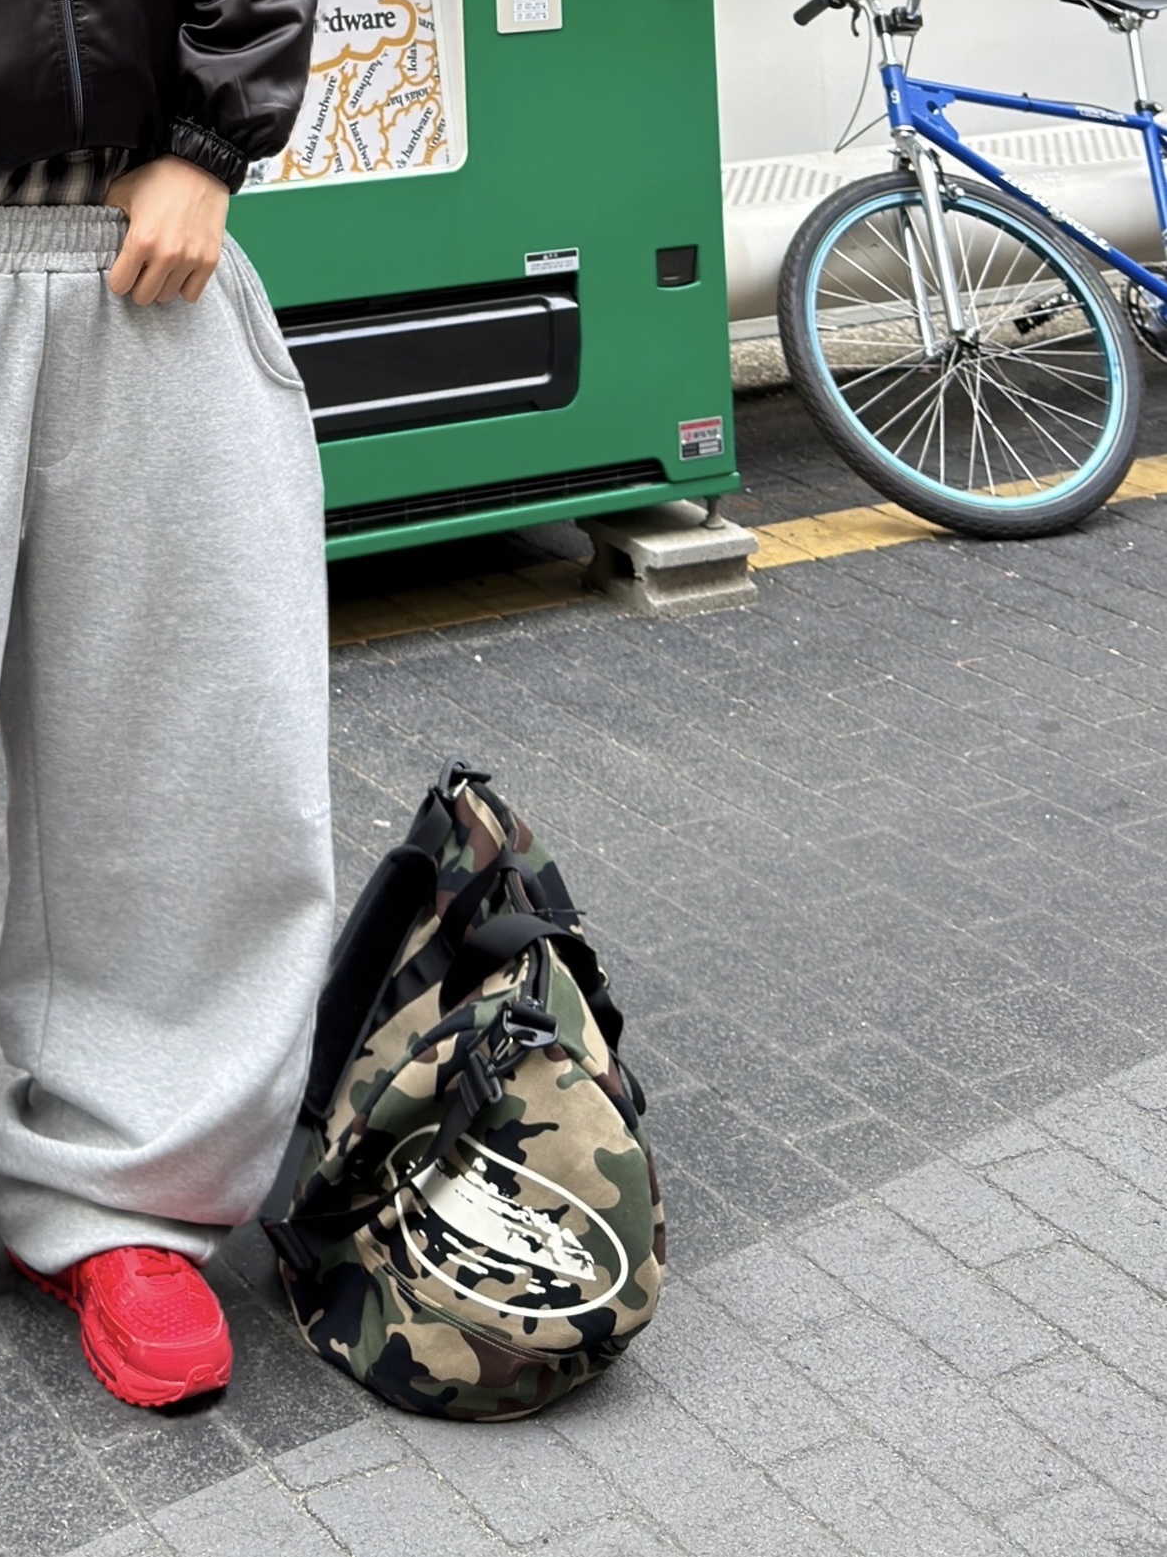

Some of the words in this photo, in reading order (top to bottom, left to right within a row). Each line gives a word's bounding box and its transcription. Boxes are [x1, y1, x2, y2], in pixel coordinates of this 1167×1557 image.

[349, 58, 383, 109] hardware
[890, 89, 901, 104] 9
[302, 134, 320, 165] lola's
[317, 75, 338, 132] hardware
[403, 106, 434, 160] hardware
